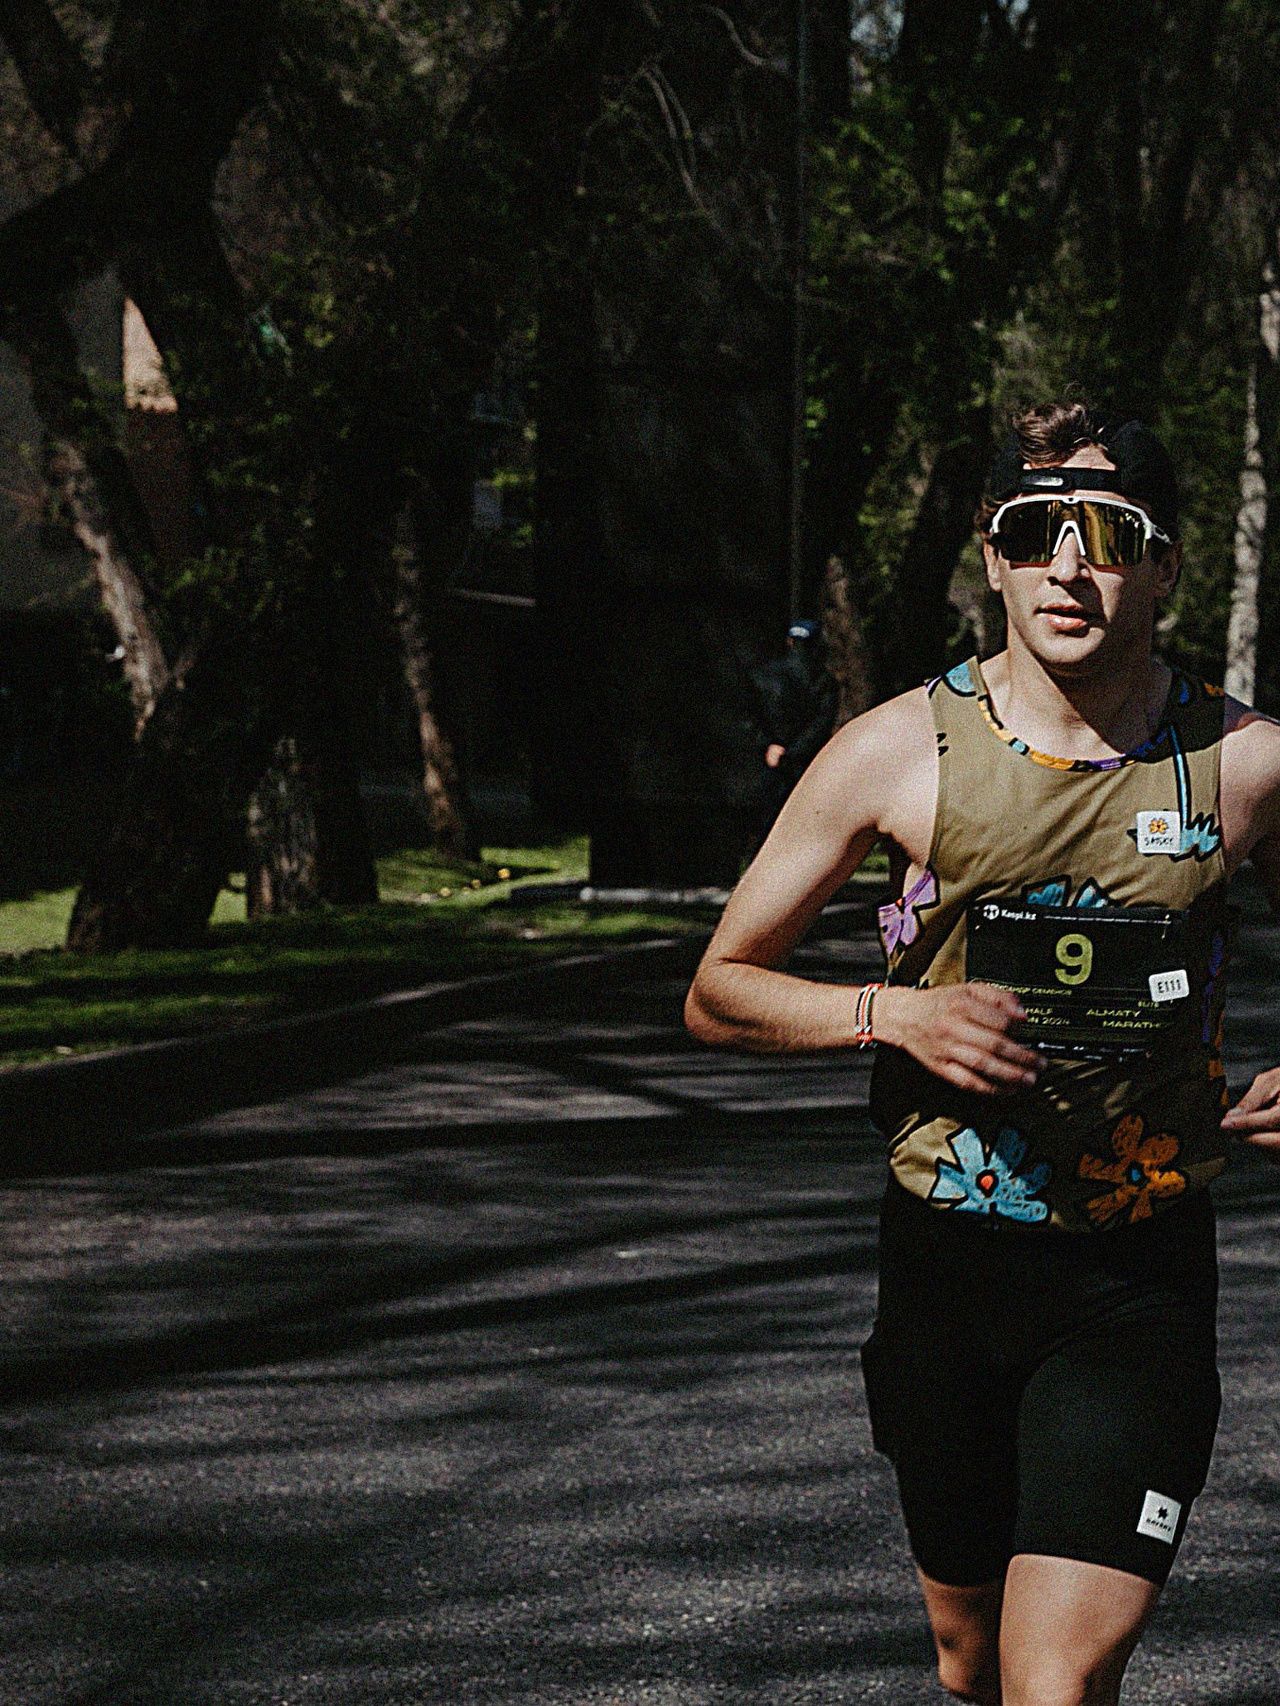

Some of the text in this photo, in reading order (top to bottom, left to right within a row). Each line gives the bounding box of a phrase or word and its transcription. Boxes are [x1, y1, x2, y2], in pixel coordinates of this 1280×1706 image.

[1054, 932, 1094, 986] 9
[1157, 978, 1181, 993] E111
[1085, 1008, 1142, 1018] ALMATY
